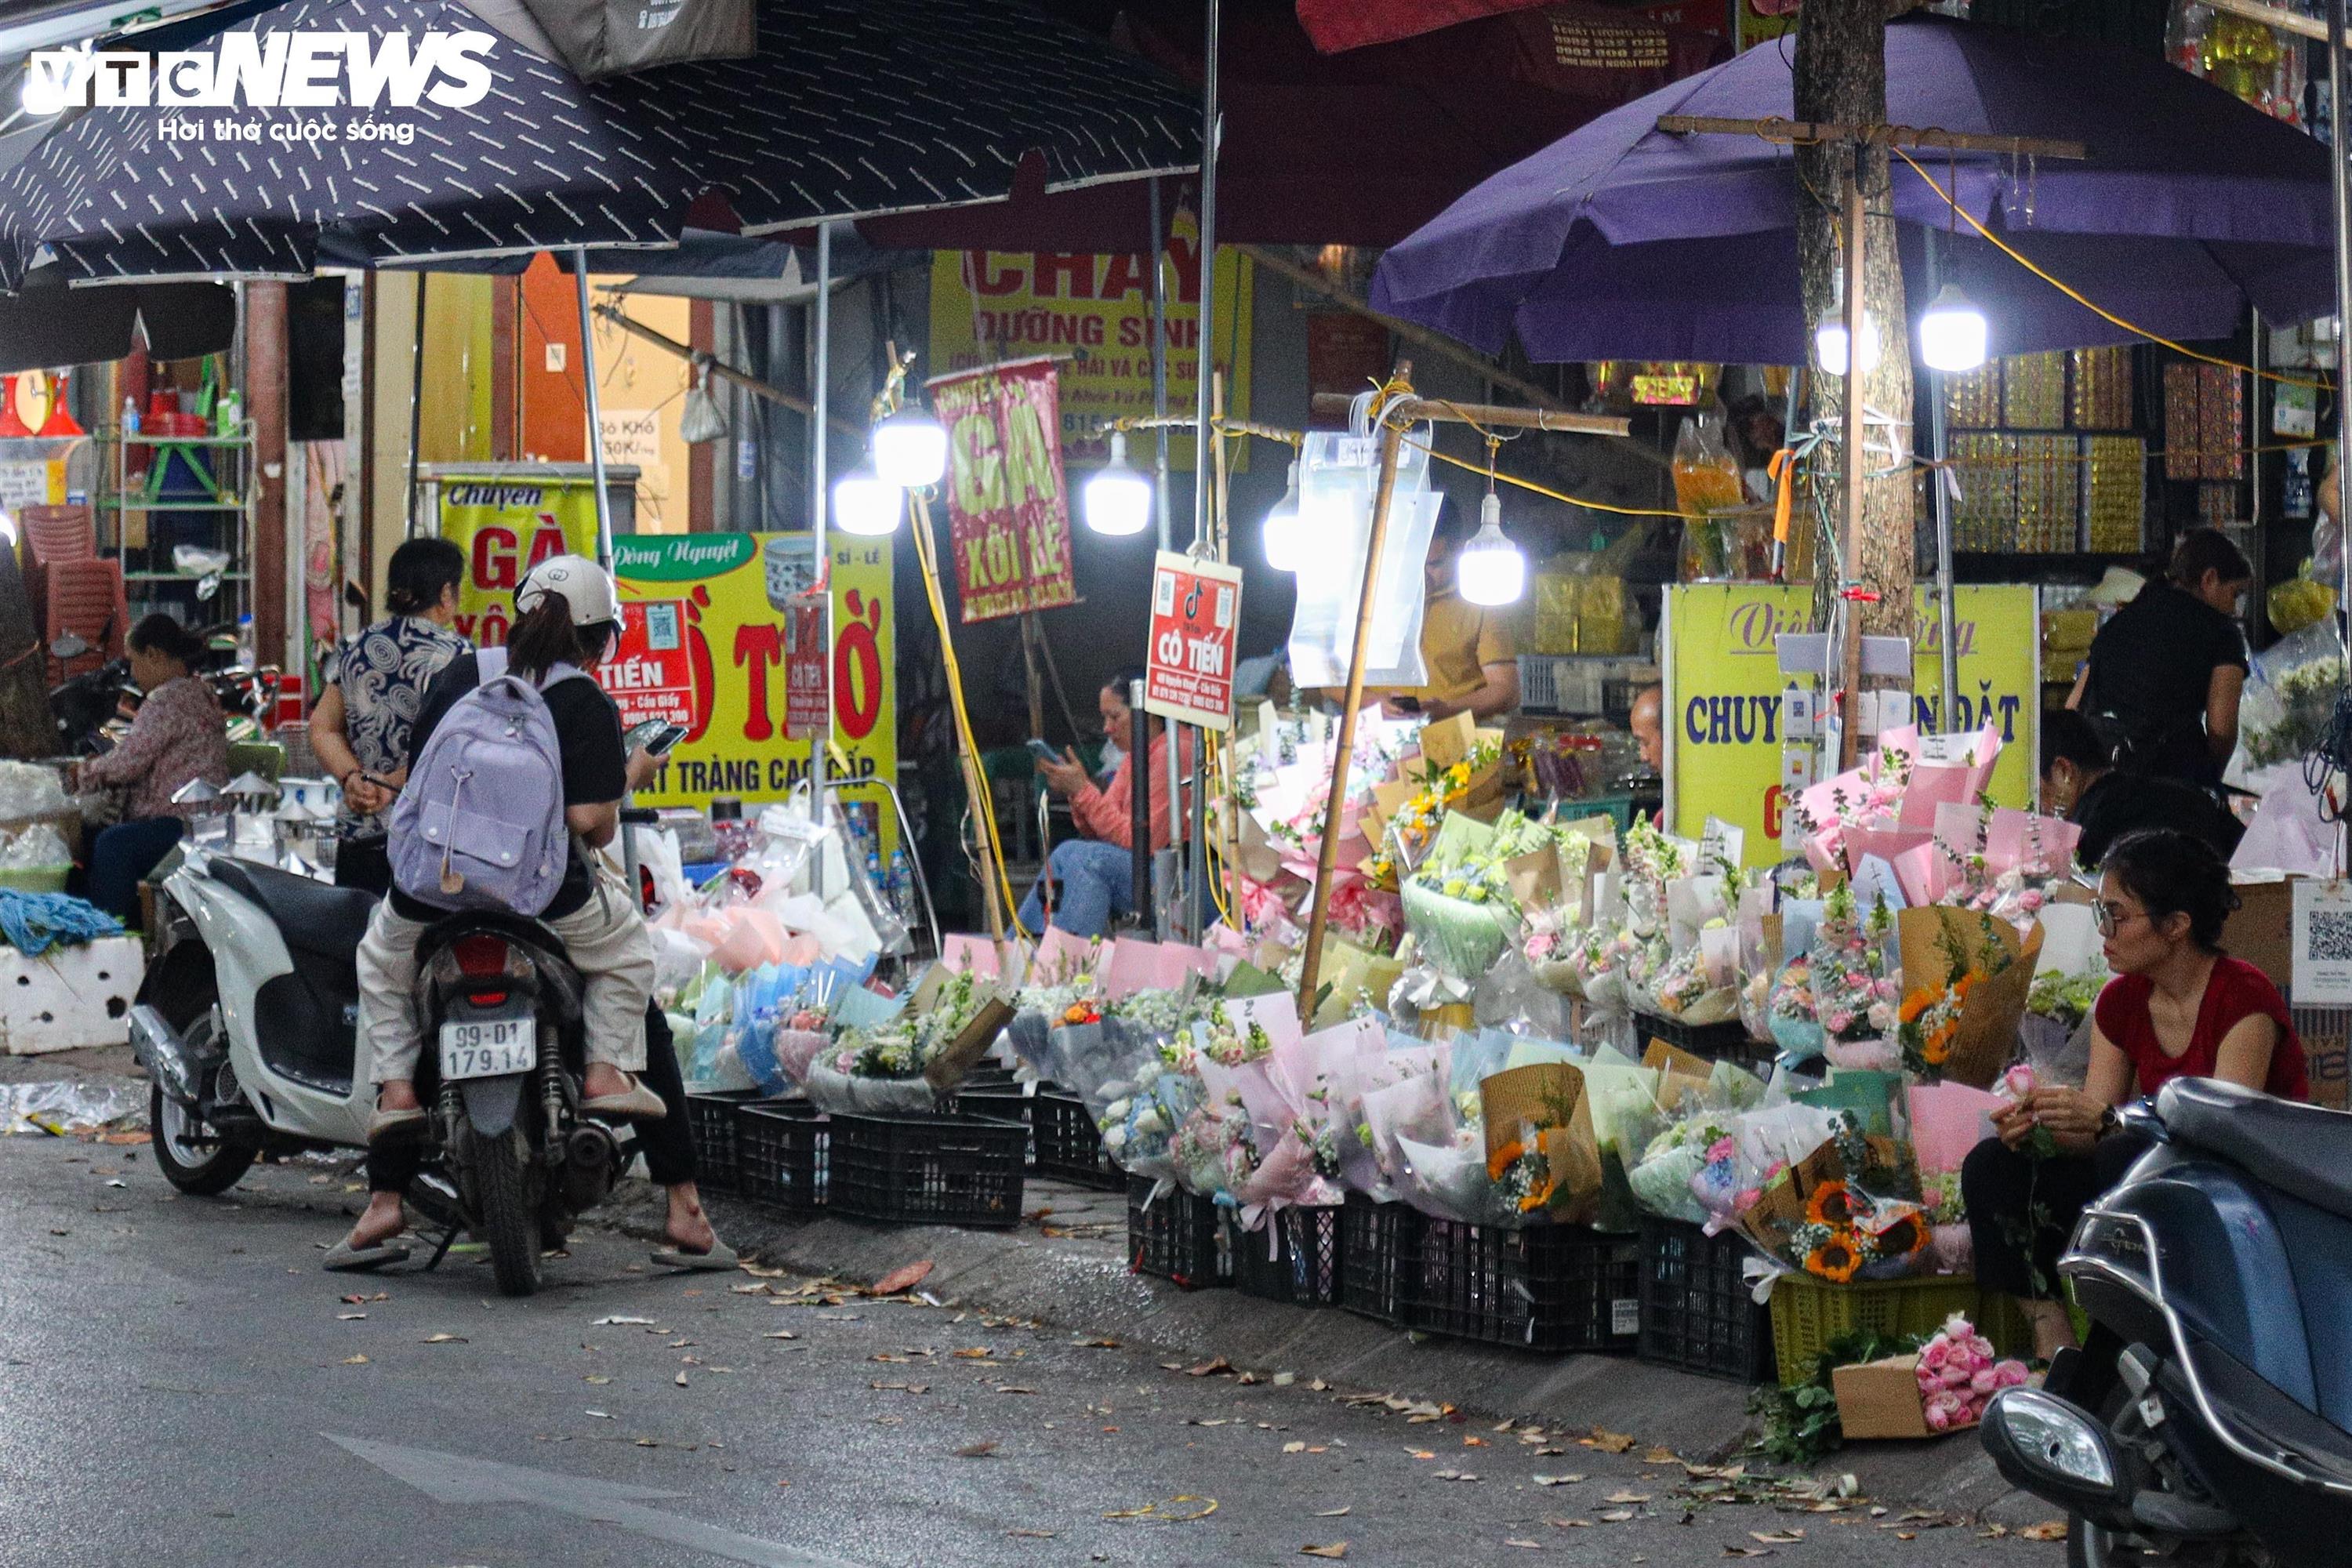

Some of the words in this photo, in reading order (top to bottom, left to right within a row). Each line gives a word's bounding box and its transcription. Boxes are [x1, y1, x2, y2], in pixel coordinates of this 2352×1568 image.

[472, 513, 567, 590] GÀ
[597, 654, 664, 690] TIẾN
[1158, 629, 1183, 666] CÔ
[1187, 631, 1225, 677] TIẾN
[677, 753, 753, 793] TRÀNG
[456, 1022, 517, 1048] 99-D1
[449, 1046, 528, 1075] 179.14
